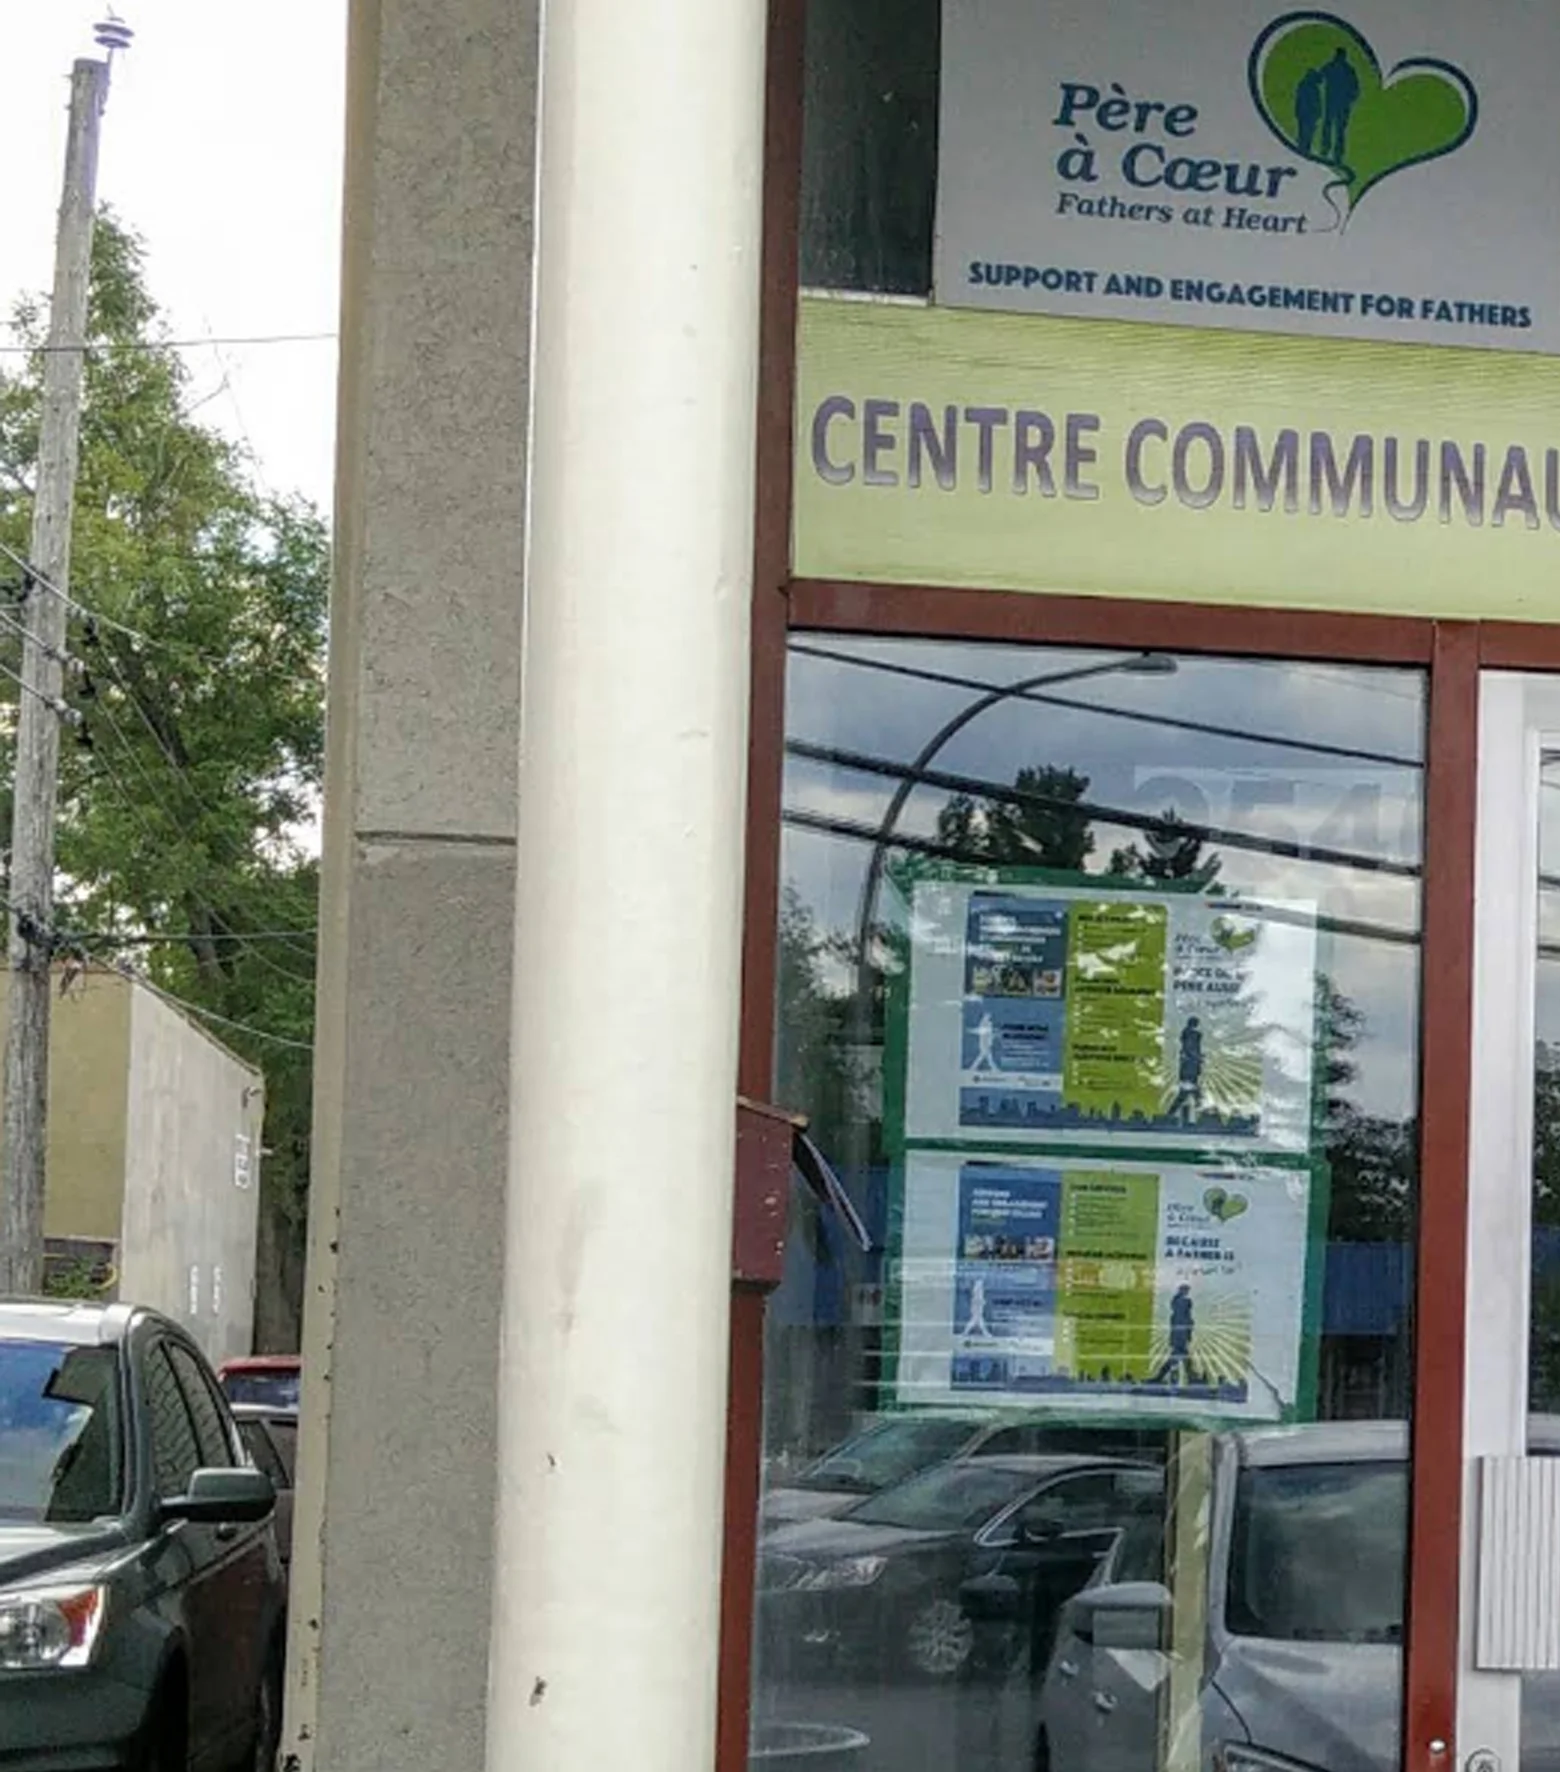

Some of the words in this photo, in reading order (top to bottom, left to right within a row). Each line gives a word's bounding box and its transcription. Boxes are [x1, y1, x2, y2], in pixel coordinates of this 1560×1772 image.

[1052, 83, 1198, 137] Père
[1056, 138, 1096, 182] à
[1122, 142, 1298, 198] Cœur
[1056, 193, 1174, 225] Fathers
[1183, 206, 1214, 228] at
[1222, 207, 1307, 234] Heart
[968, 262, 1097, 294] SUPPORT
[1103, 272, 1164, 299] AND
[1170, 279, 1355, 315] ENGAGEMENT
[1361, 292, 1417, 319] FOR
[1421, 297, 1532, 329] FATHERS
[811, 395, 1101, 501] CENTRE
